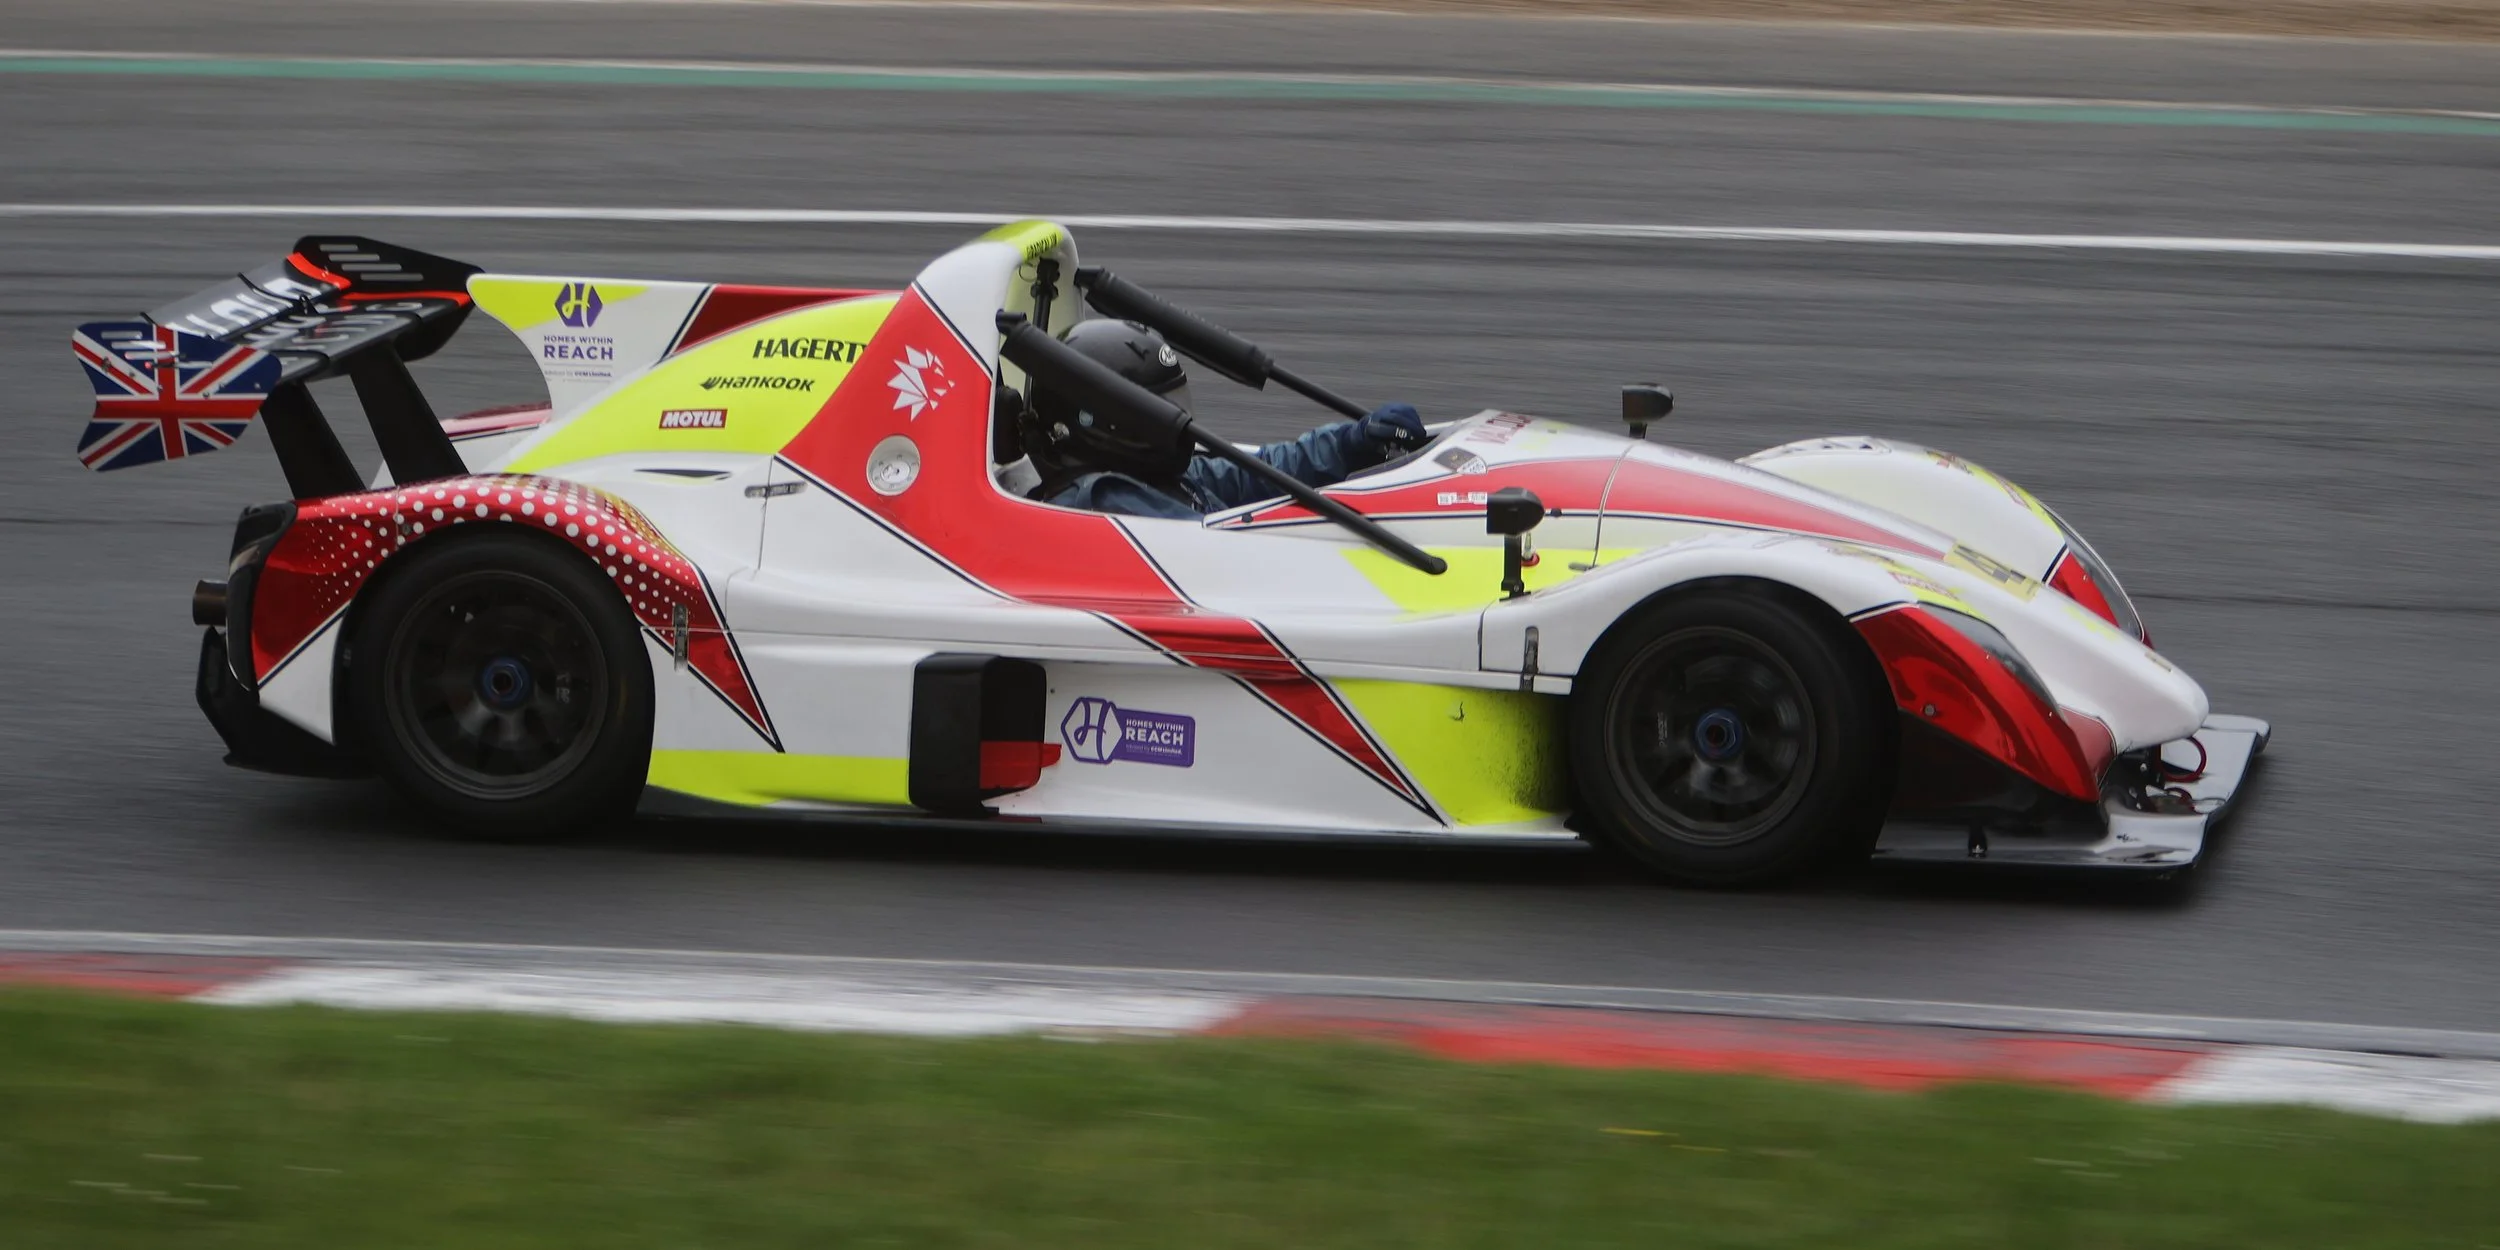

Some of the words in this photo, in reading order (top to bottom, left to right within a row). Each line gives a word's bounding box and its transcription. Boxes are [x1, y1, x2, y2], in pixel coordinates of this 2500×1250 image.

[544, 335, 576, 343] HOMES
[579, 336, 613, 345] WITHIN
[544, 345, 613, 360] REACH
[661, 411, 723, 427] MOTUL
[1126, 719, 1153, 729] HOMES
[1155, 721, 1184, 732] WITHIN
[1125, 727, 1184, 746] REACH
